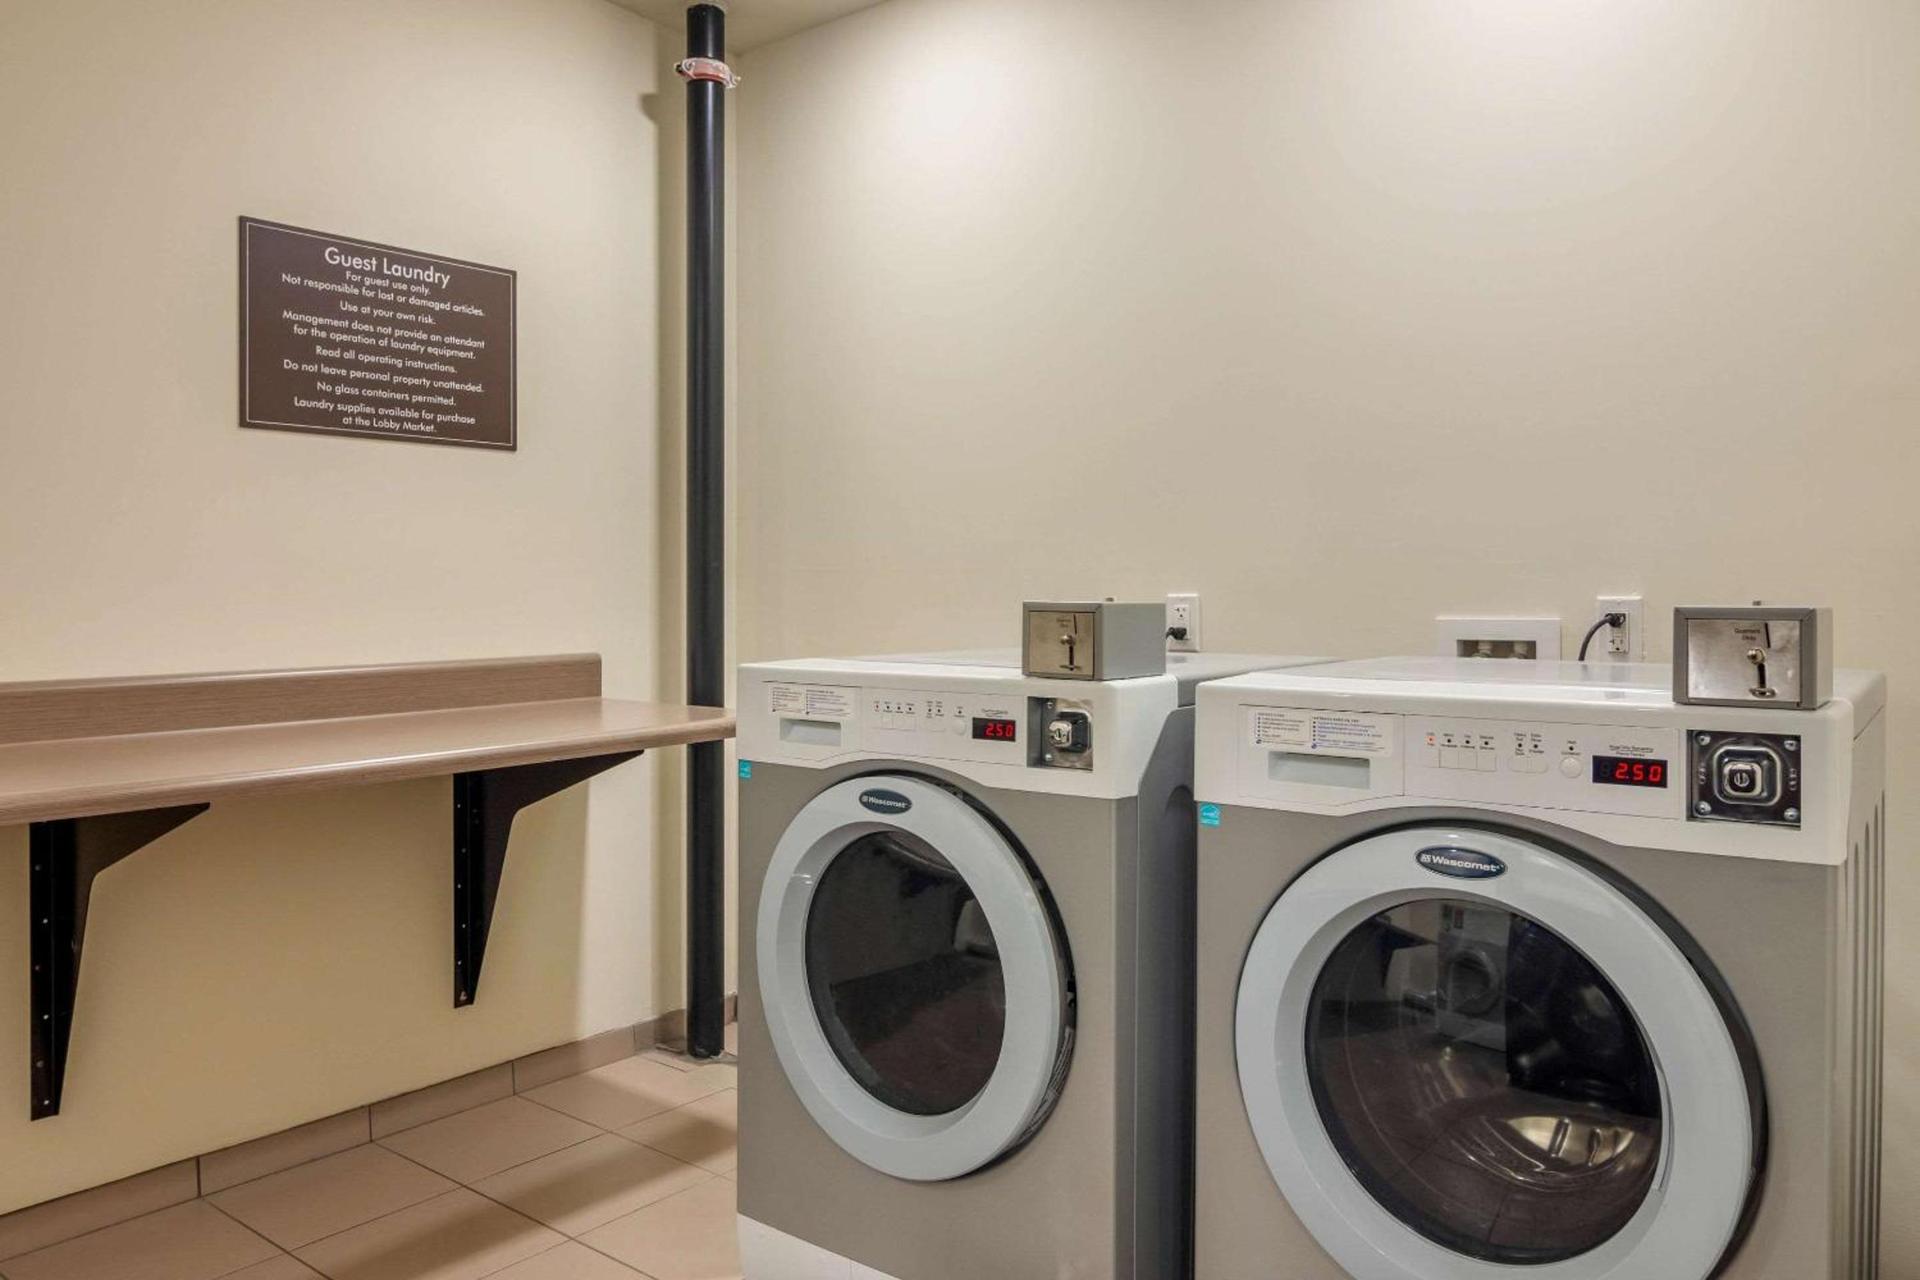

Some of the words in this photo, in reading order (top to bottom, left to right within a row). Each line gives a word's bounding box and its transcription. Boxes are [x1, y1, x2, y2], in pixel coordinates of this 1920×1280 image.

[324, 246, 377, 272] Guest
[383, 257, 451, 289] Laundry
[281, 272, 301, 285] Not
[303, 278, 360, 296] responsible
[361, 286, 376, 298] for
[378, 288, 395, 301] lost
[396, 294, 407, 303] or
[408, 295, 451, 311] damaged
[452, 302, 486, 317] articles.
[345, 270, 362, 281] For
[364, 276, 390, 287] guest
[392, 281, 408, 291] use
[410, 283, 432, 297] only.
[340, 299, 359, 312] Use
[361, 306, 371, 314] at
[373, 307, 395, 319] your
[396, 311, 416, 321] own
[418, 313, 437, 325] risk.
[281, 309, 349, 327] Management
[351, 320, 375, 333] does
[376, 325, 393, 335] not
[394, 328, 428, 340] provide
[430, 334, 443, 343] an
[444, 335, 485, 349] attendant
[293, 323, 309, 335] for
[311, 326, 328, 339] the
[329, 331, 376, 345] operation
[378, 337, 389, 347] of
[390, 337, 426, 354] laundry
[427, 345, 476, 360] equipment.
[315, 344, 341, 358] Read
[343, 349, 356, 360] all
[358, 353, 403, 368] operating
[404, 357, 458, 374] instructions.
[283, 359, 299, 371] Do
[301, 363, 318, 373] not
[320, 363, 348, 376] leave
[350, 369, 391, 381] personal
[392, 374, 431, 389] property
[432, 380, 485, 394] unattended.
[316, 381, 333, 392] No
[334, 383, 360, 395] glass
[361, 387, 410, 401] containers
[411, 394, 457, 406] permitted.
[293, 395, 335, 412] Laundry
[337, 401, 376, 415] supplies
[378, 406, 420, 419] available
[421, 409, 435, 420] for
[437, 412, 477, 425] purchase
[342, 416, 353, 426] at
[355, 416, 371, 427] the
[373, 417, 401, 431] Lobby
[402, 420, 438, 433] Market.
